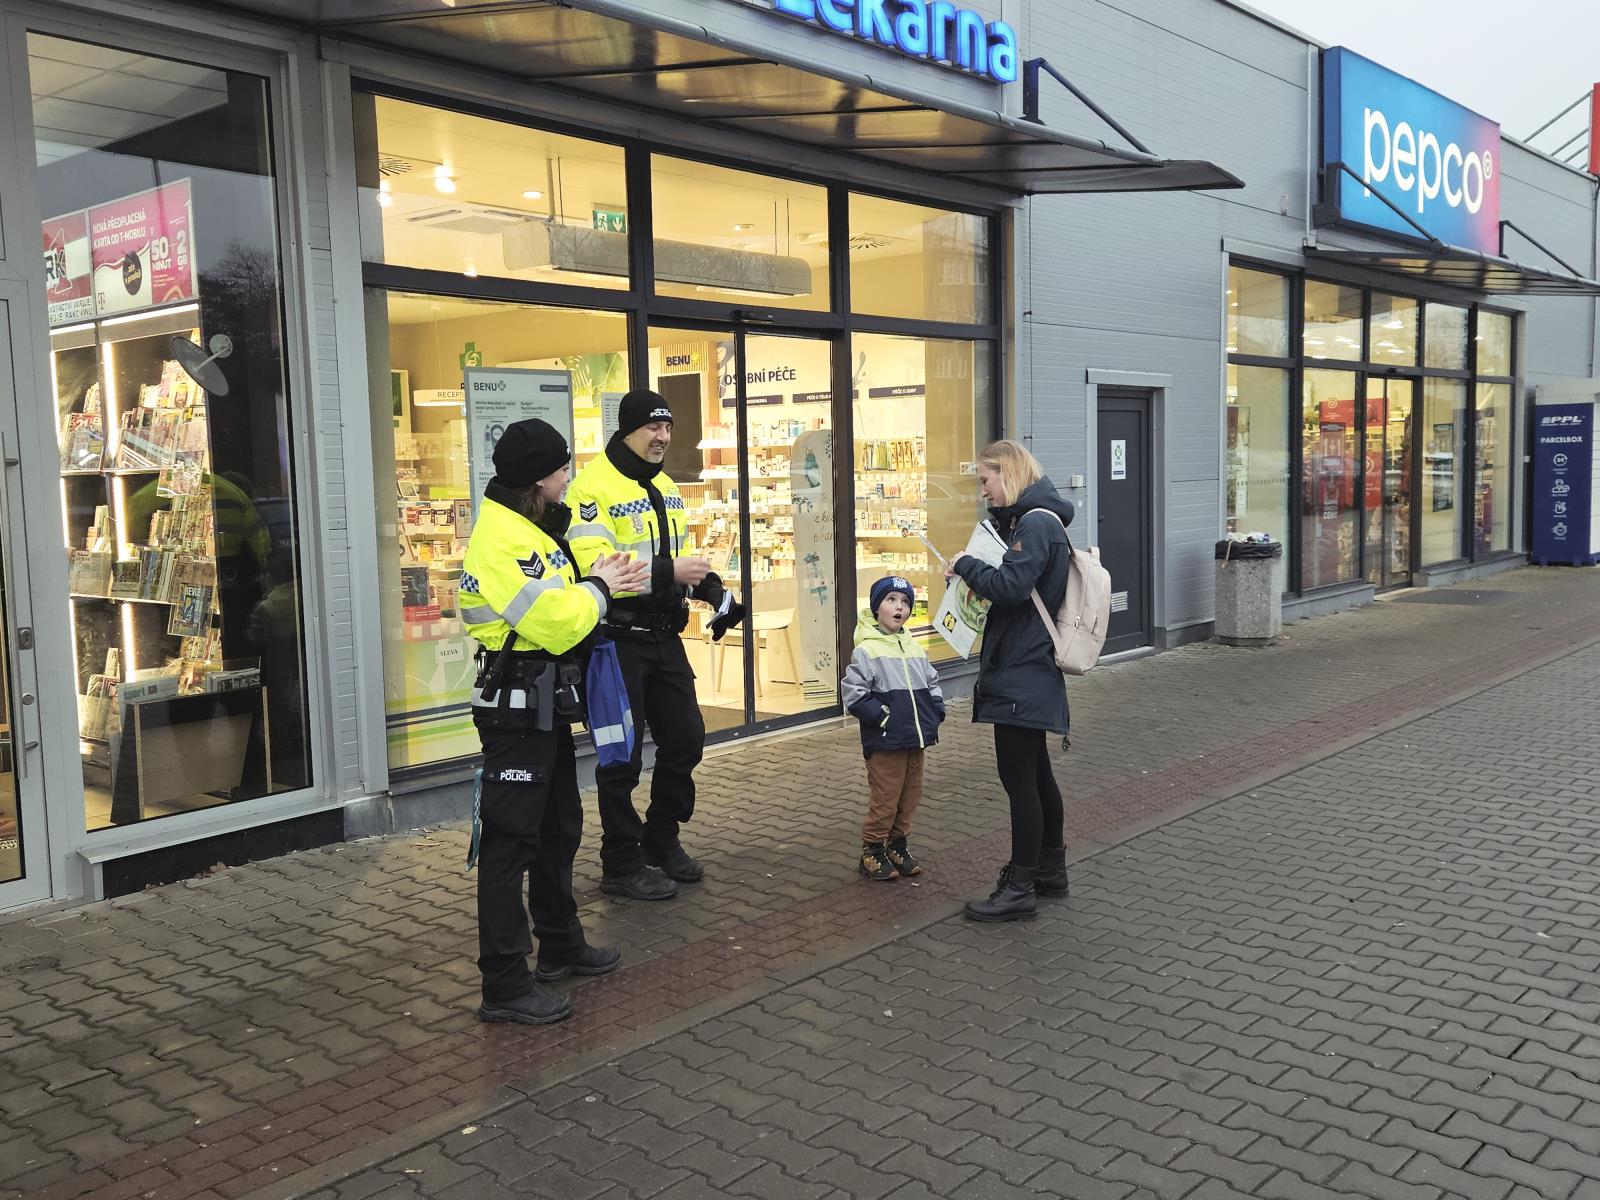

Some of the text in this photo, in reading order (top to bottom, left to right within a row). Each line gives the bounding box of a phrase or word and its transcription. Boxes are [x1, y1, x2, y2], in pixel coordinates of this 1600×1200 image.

[775, 0, 1017, 84] karna
[1364, 107, 1484, 214] pepco
[93, 208, 146, 233] NOVÁ PŘEDPLACENÁ
[94, 236, 111, 249] KARTA
[119, 227, 146, 242] T-MOBILU
[151, 230, 187, 259] 50 2
[152, 258, 172, 271] MINUT
[666, 355, 690, 366] BENU
[474, 382, 497, 391] BENU
[725, 366, 796, 386] OSBNÍ PÉČE
[500, 772, 532, 781] POLICIE
